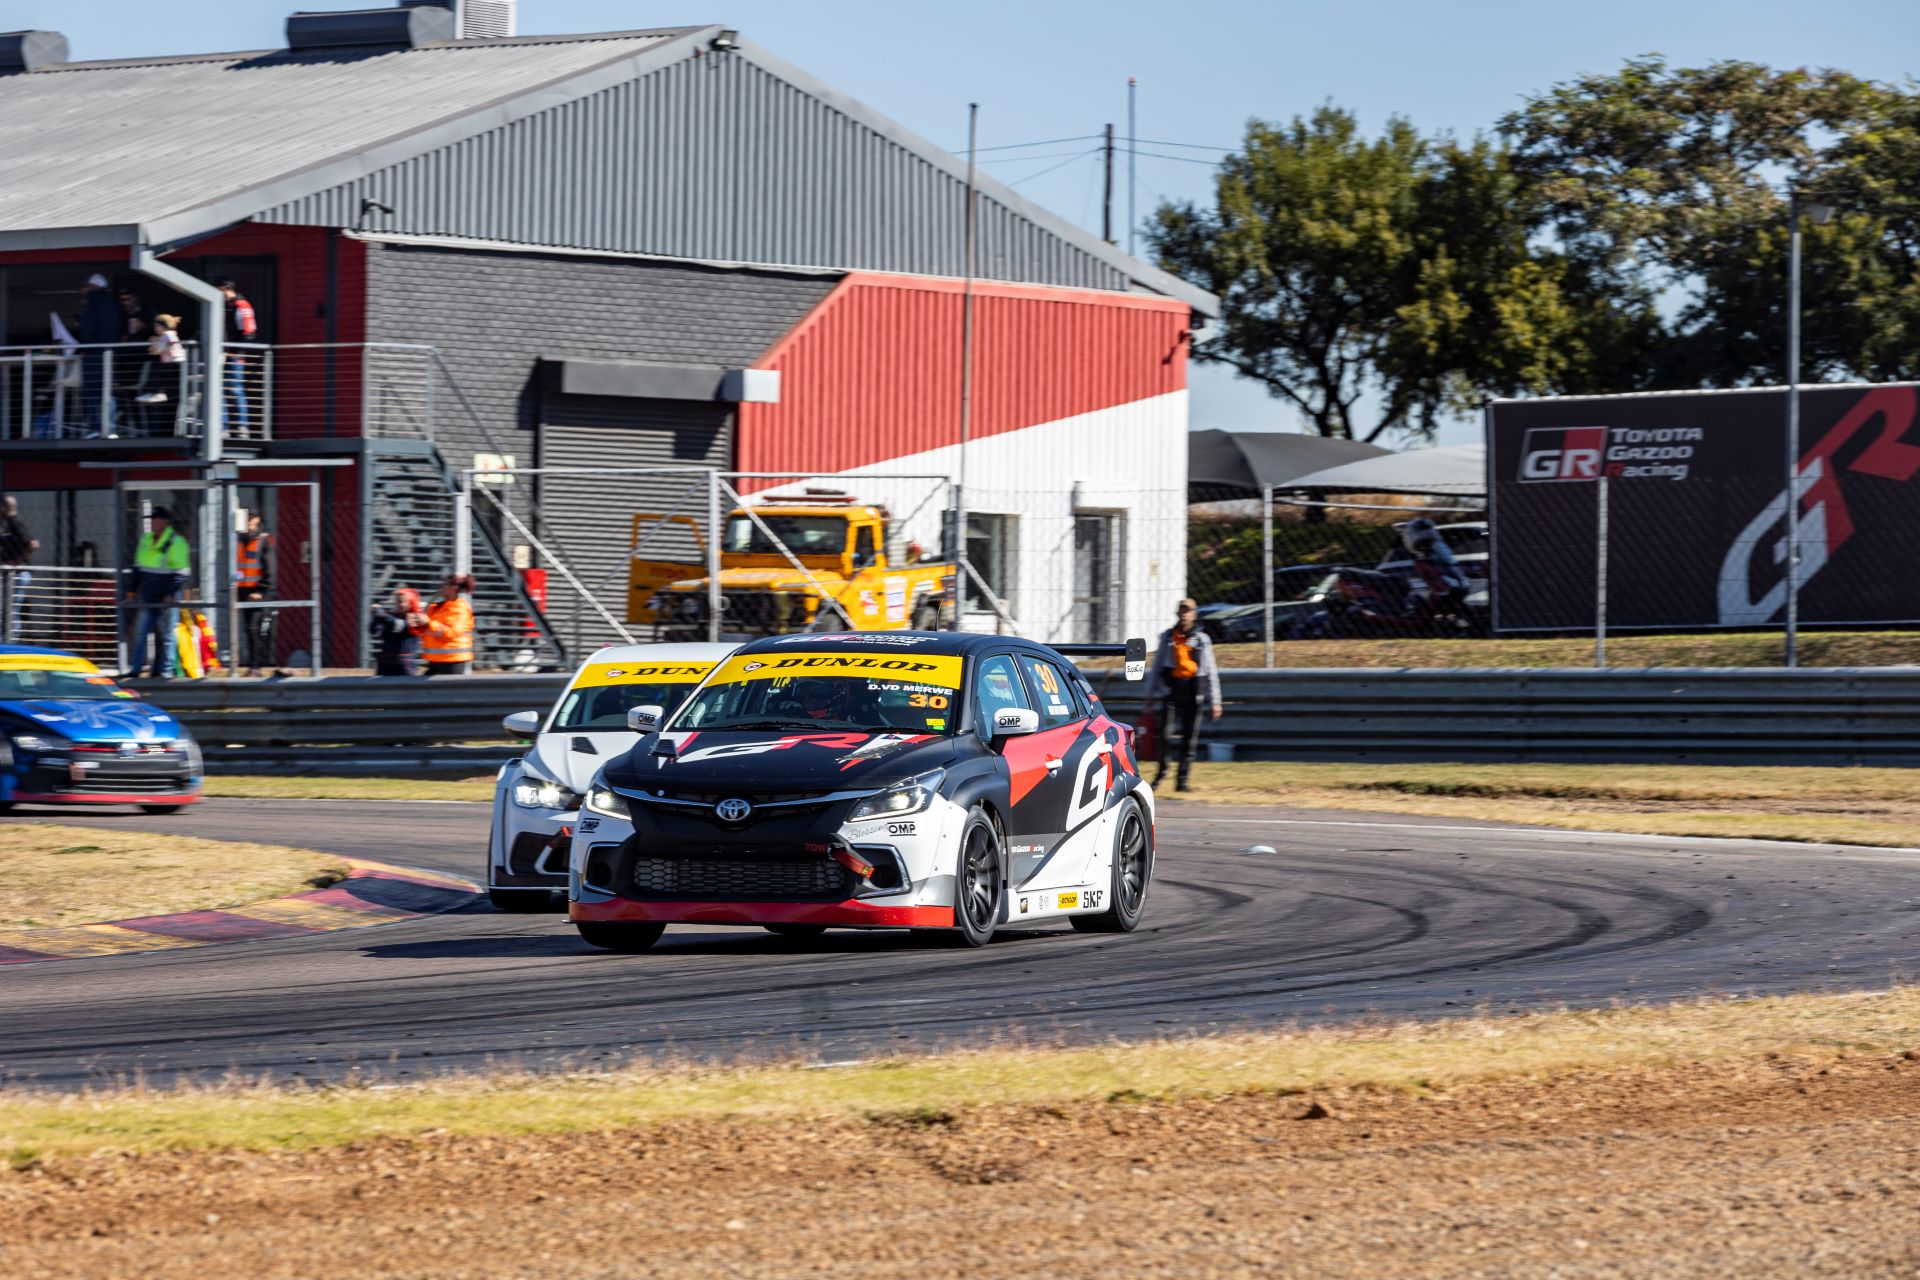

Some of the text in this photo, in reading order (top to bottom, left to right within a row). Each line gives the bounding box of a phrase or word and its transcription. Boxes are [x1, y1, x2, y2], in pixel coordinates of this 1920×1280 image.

[1610, 427, 1703, 443] TOYOTA
[1606, 445, 1694, 461] GAZOO
[1523, 449, 1600, 478] GR
[1603, 462, 1689, 481] Racing
[632, 667, 708, 676] DUN
[771, 657, 938, 672] DUNLOP
[1034, 663, 1059, 694] 30
[903, 685, 953, 696] MERWE
[907, 693, 949, 709] 30
[638, 714, 655, 724] OMP
[999, 717, 1021, 726] OMP
[677, 732, 870, 763] GR
[888, 823, 916, 834] OMP
[1082, 890, 1103, 909] SKF
